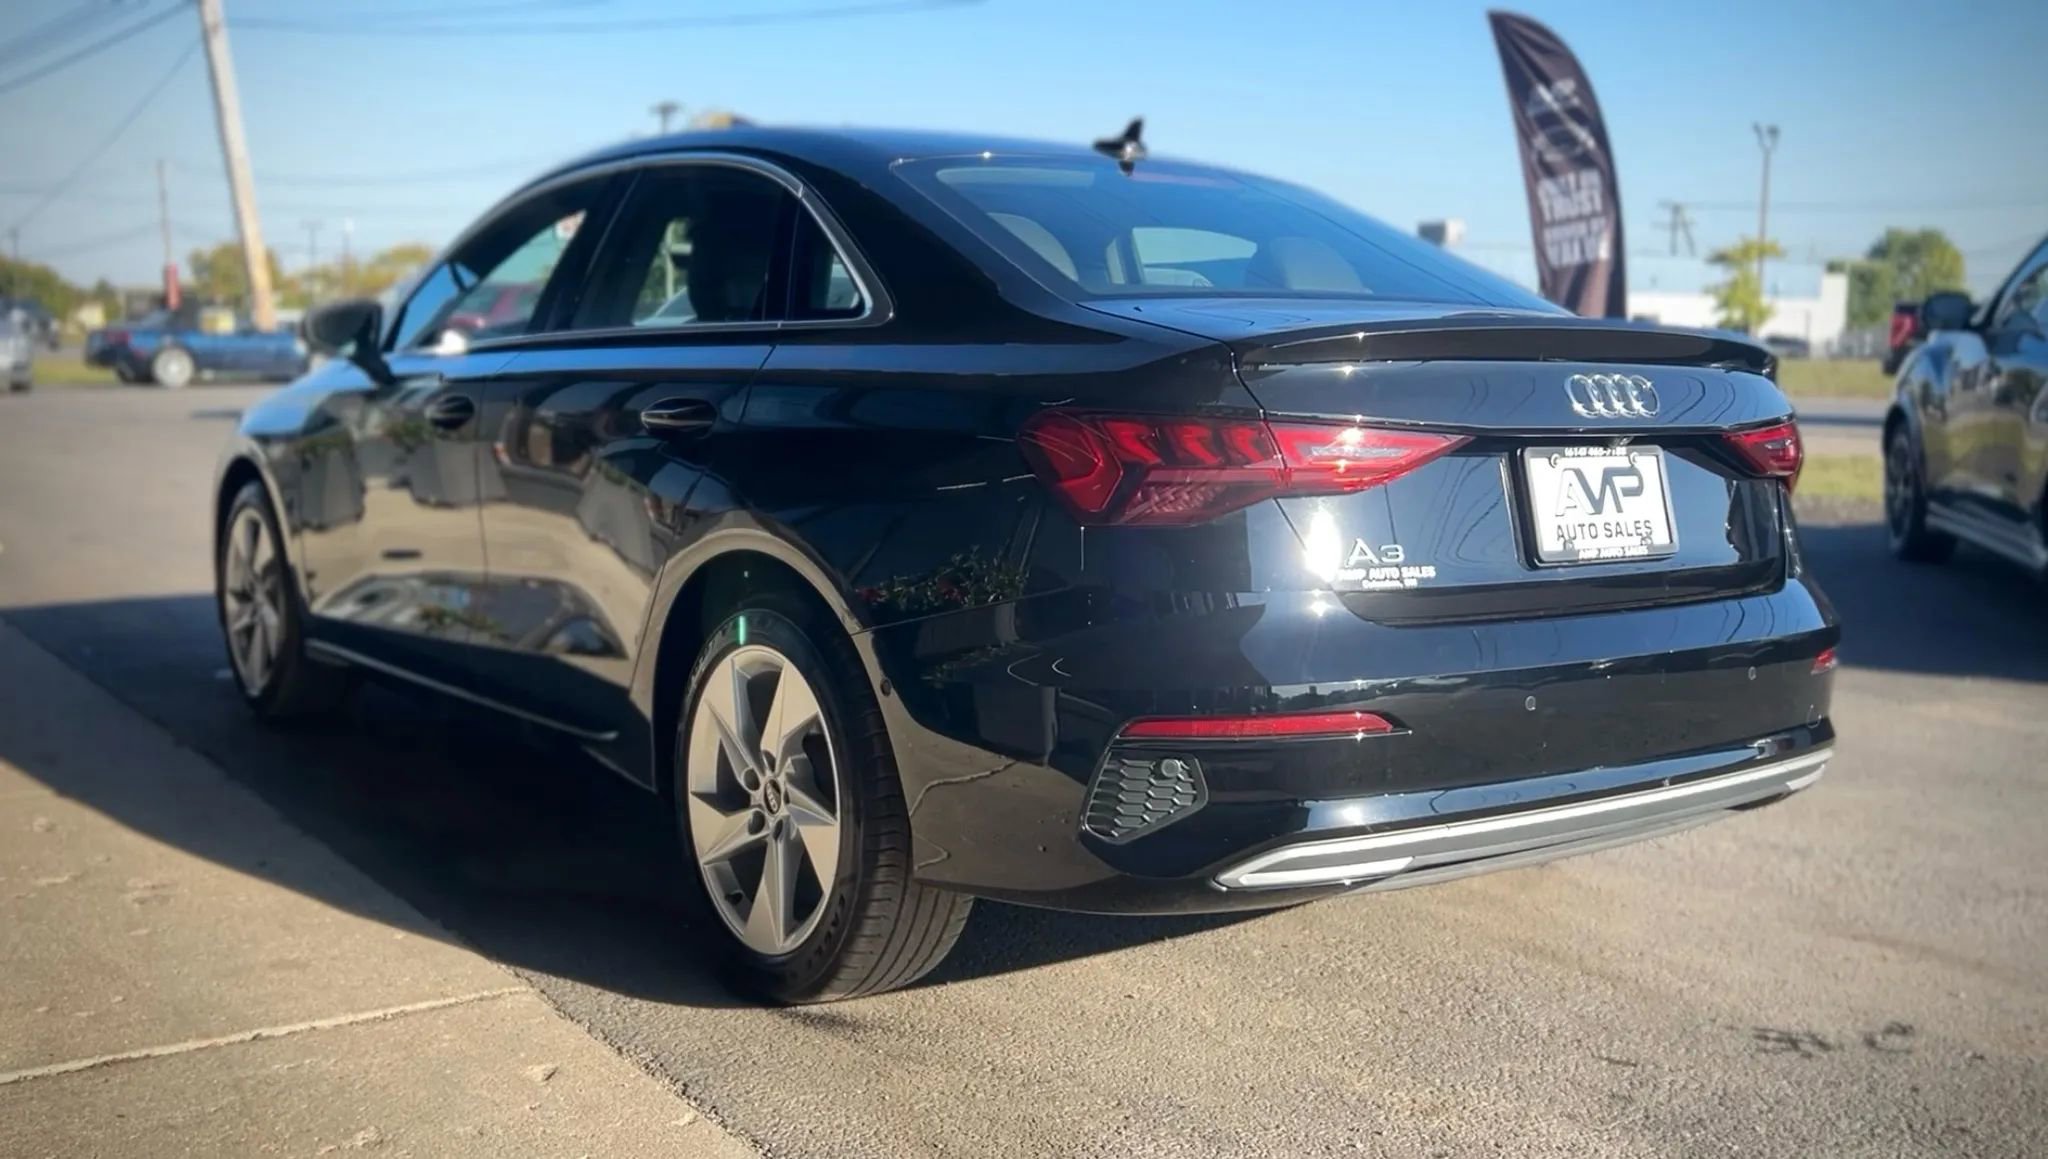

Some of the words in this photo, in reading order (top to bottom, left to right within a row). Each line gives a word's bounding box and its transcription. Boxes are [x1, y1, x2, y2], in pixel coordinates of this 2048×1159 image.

[1557, 523, 1599, 541] AUTO
[1604, 520, 1653, 539] SALES
[1343, 538, 1405, 568] A3
[1369, 567, 1400, 580] AUTO
[1401, 565, 1436, 579] SALES
